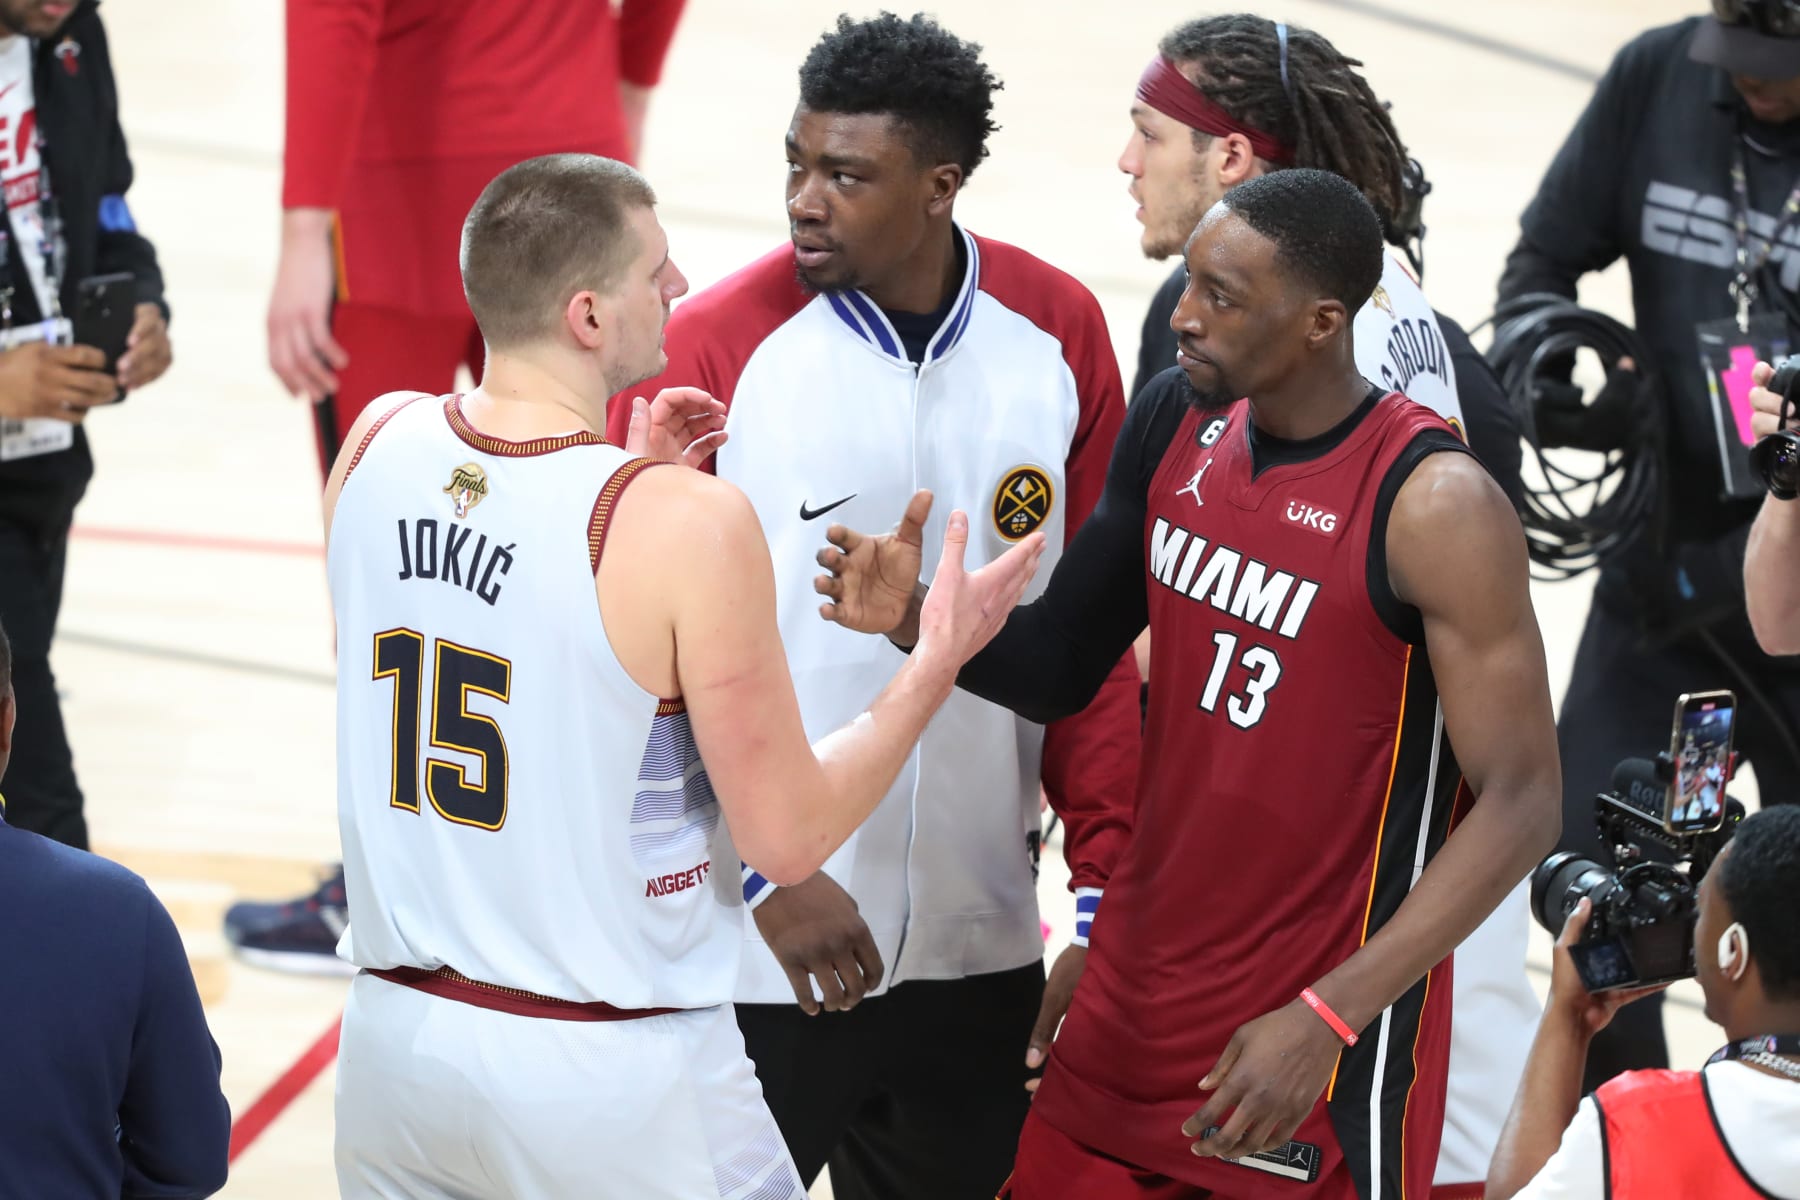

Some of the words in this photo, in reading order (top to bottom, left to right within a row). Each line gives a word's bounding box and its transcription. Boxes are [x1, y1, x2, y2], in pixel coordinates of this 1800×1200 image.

[1381, 318, 1448, 394] GORDON
[1200, 419, 1226, 446] 6
[444, 469, 486, 494] Finals
[397, 518, 516, 606] JOKIĆ
[1149, 516, 1322, 640] MIAMI
[1200, 630, 1283, 730] 13
[372, 627, 512, 831] 15
